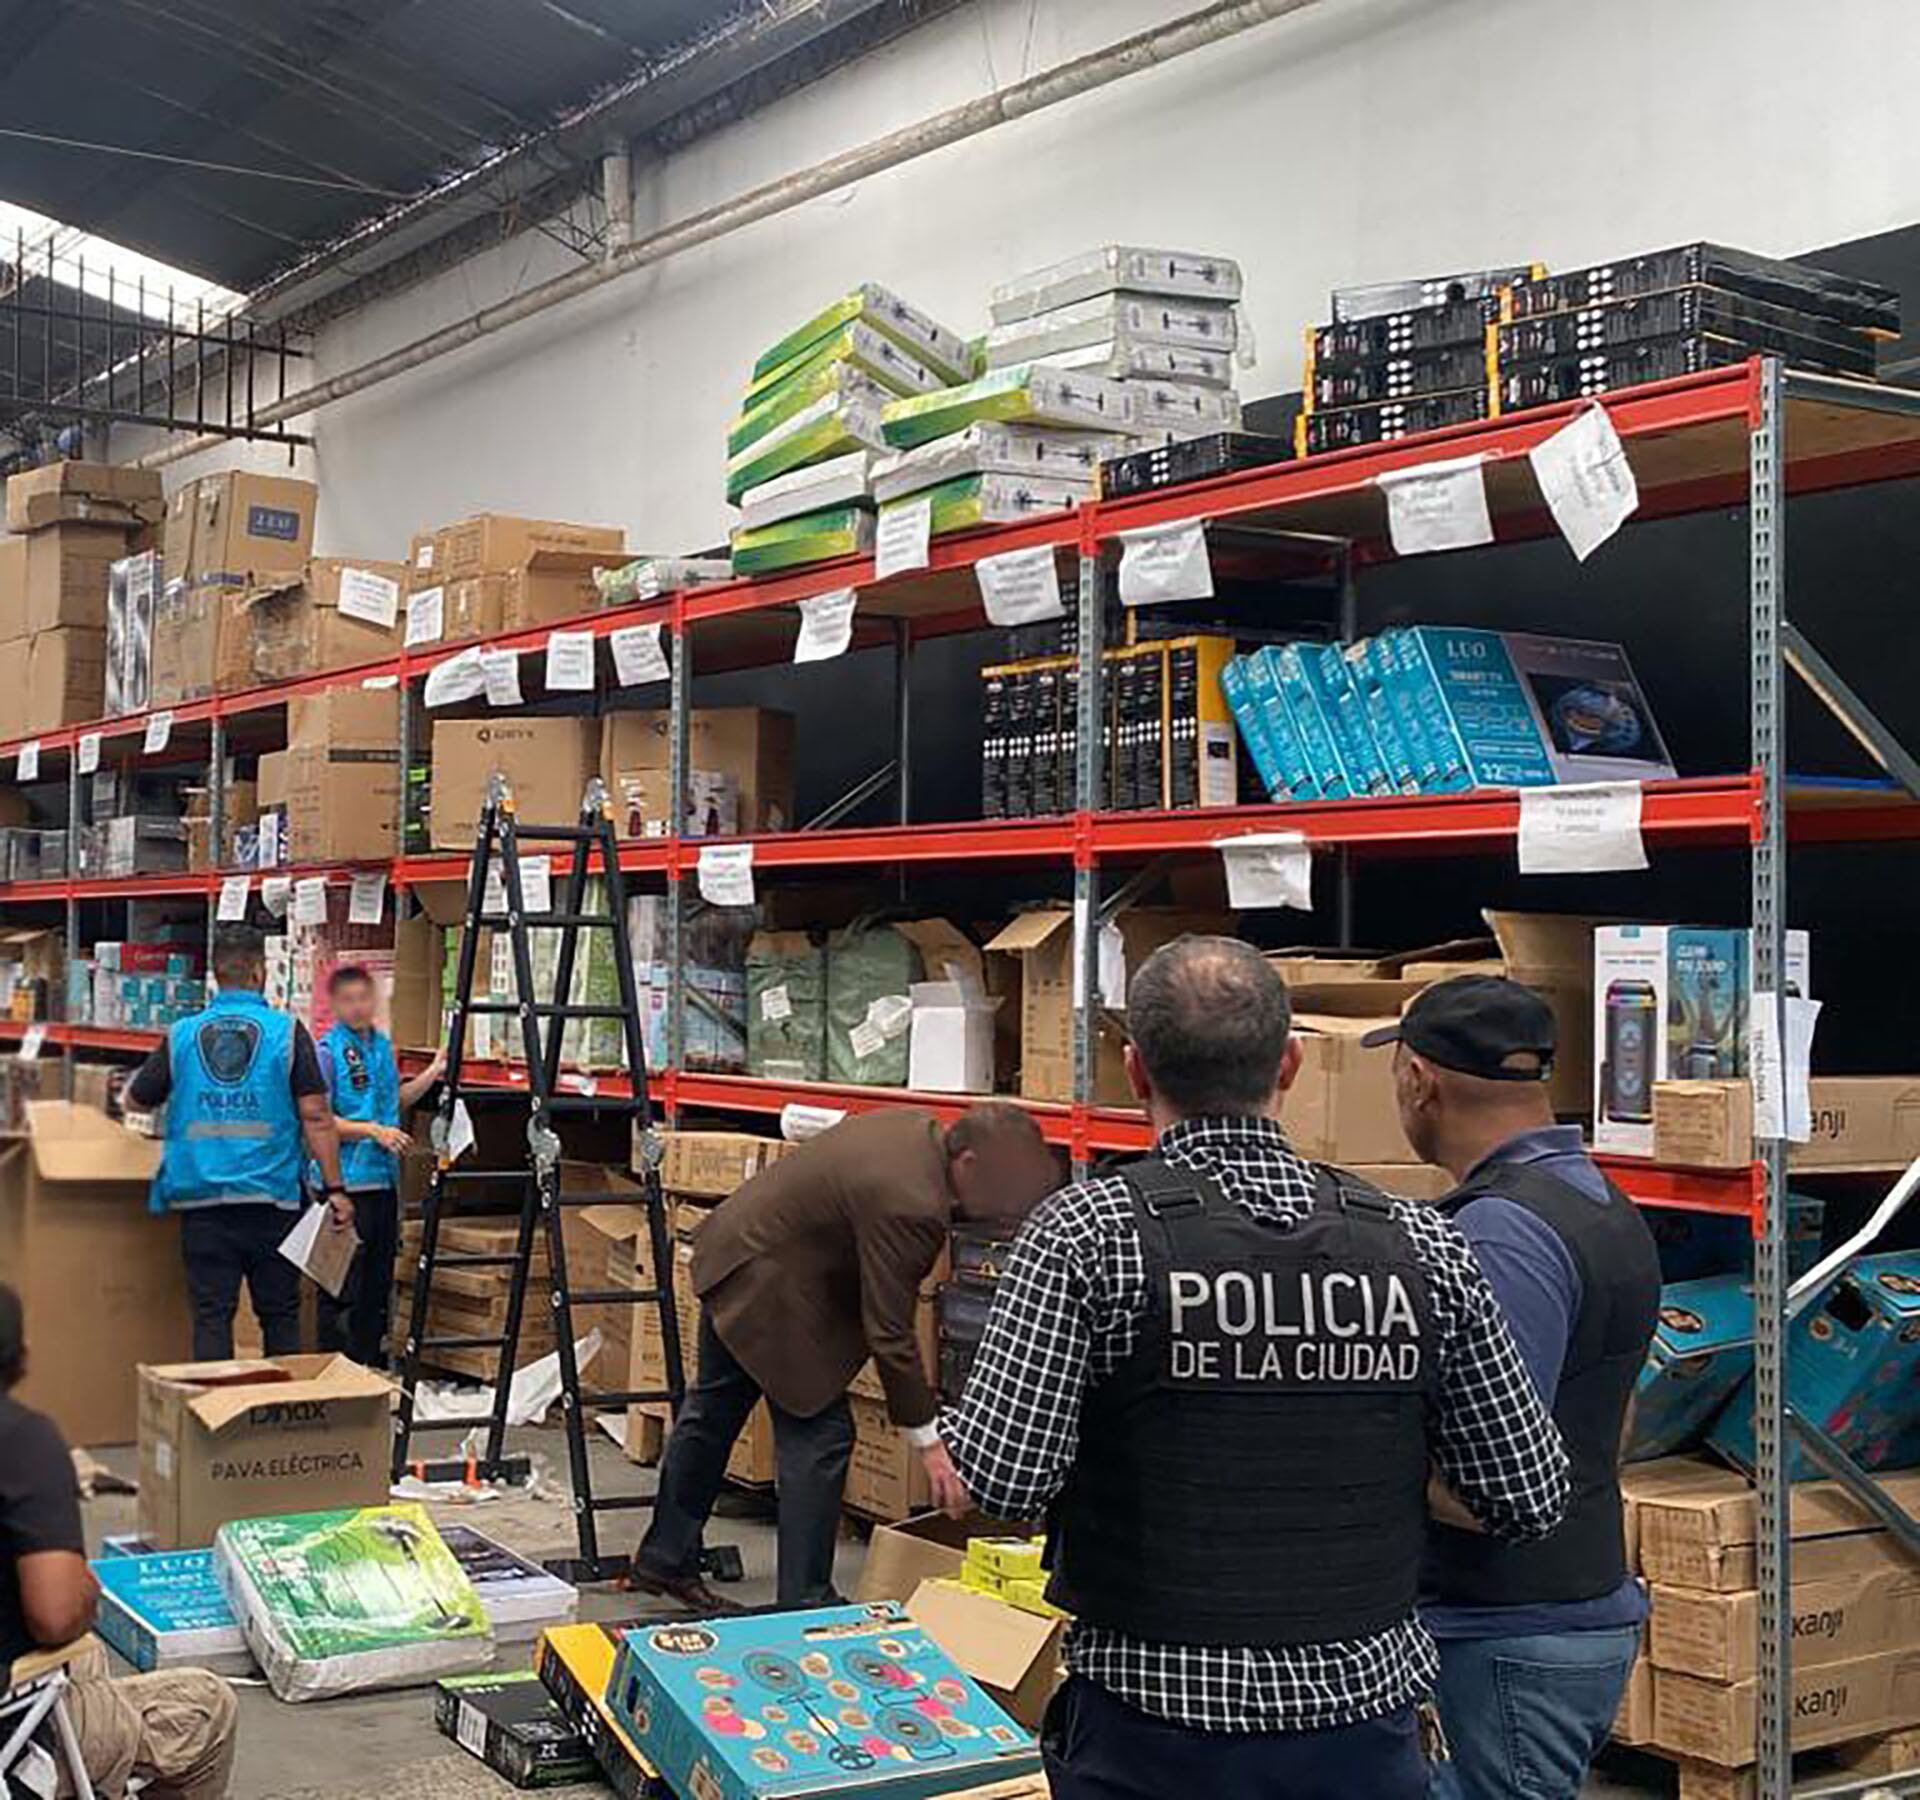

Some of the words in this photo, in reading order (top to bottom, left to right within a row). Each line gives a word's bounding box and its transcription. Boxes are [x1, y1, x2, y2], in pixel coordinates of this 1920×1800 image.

[1168, 1271, 1420, 1338] POLICIA
[1171, 1341, 1221, 1379] DE
[1235, 1342, 1284, 1380] LA
[1295, 1342, 1421, 1382] CIUDAD
[211, 1460, 265, 1481] PAVA
[268, 1451, 364, 1477] ELÉCTRICA
[1794, 1686, 1848, 1718] kanji
